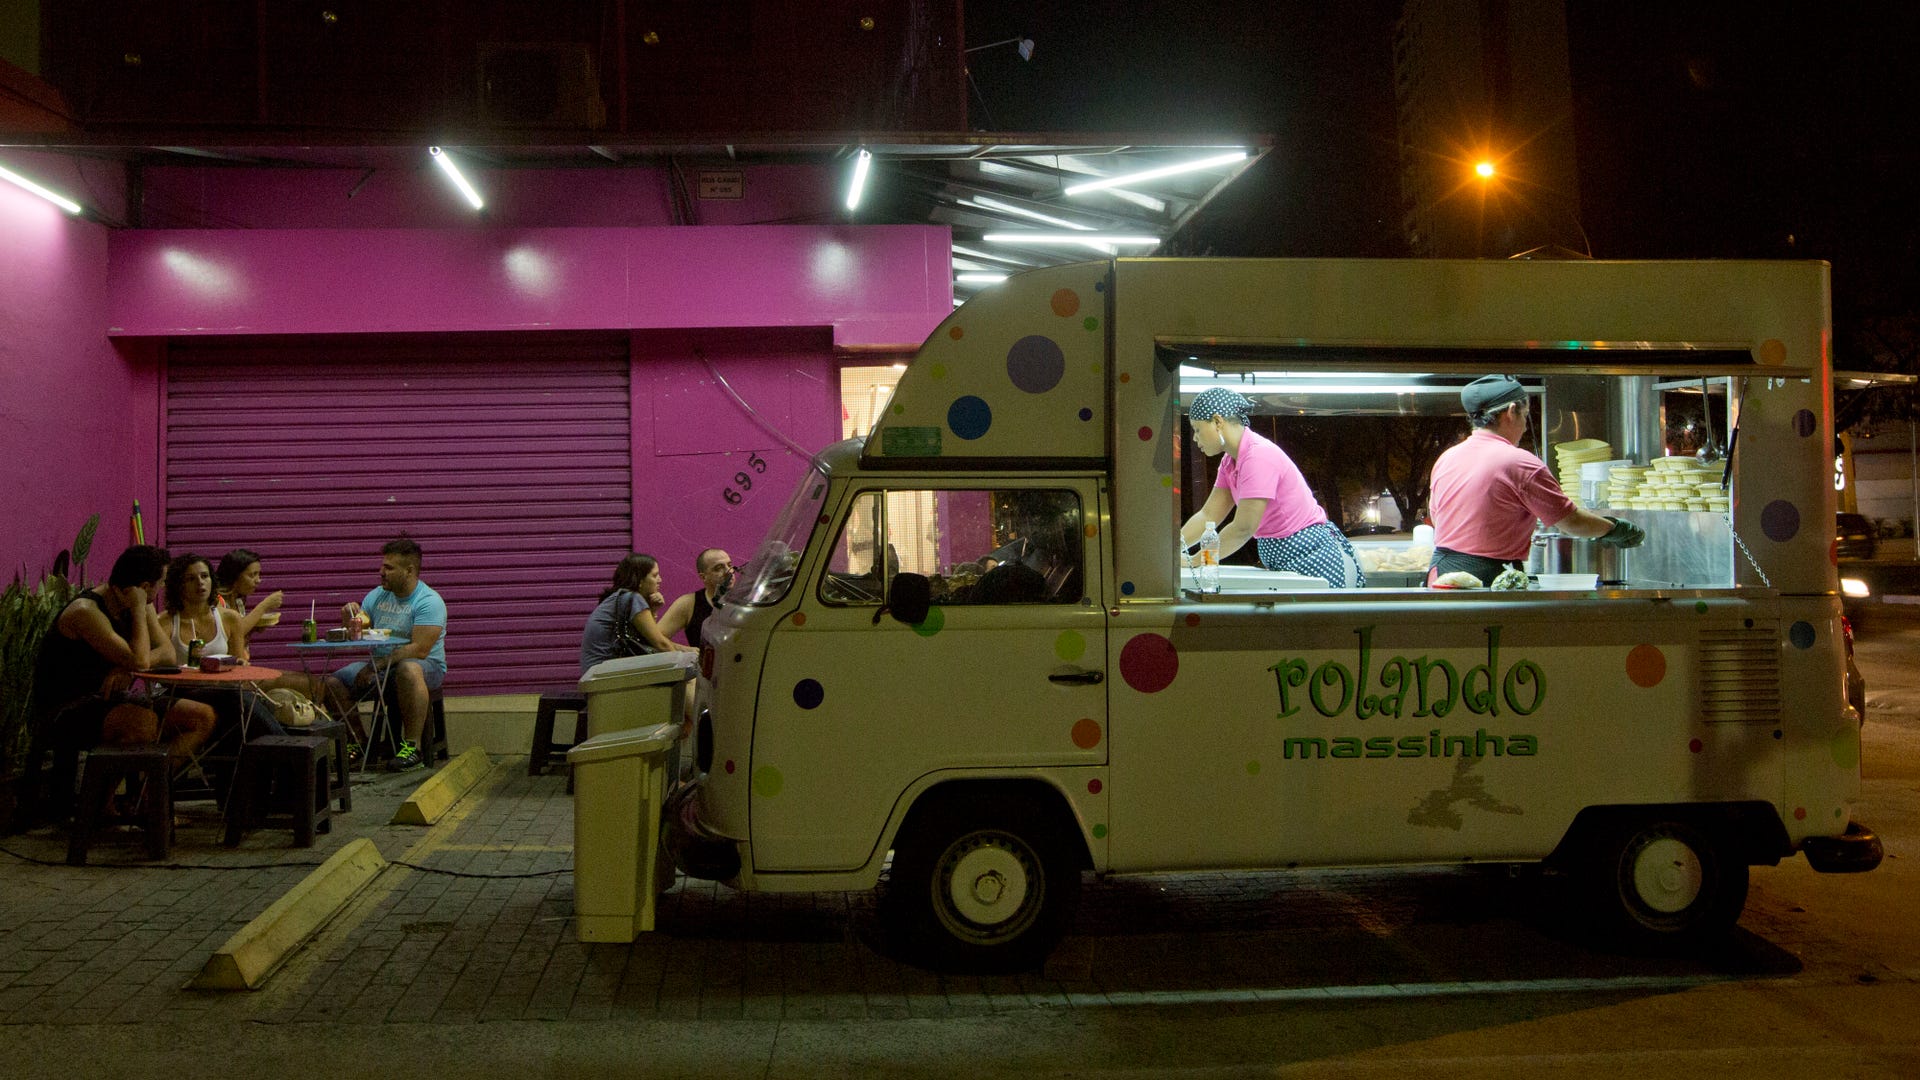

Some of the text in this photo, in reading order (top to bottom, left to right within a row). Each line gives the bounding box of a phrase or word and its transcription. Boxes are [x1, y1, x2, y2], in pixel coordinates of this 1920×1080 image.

[723, 452, 766, 505] 695
[1267, 624, 1547, 720] rolando
[1283, 728, 1539, 759] massinha
